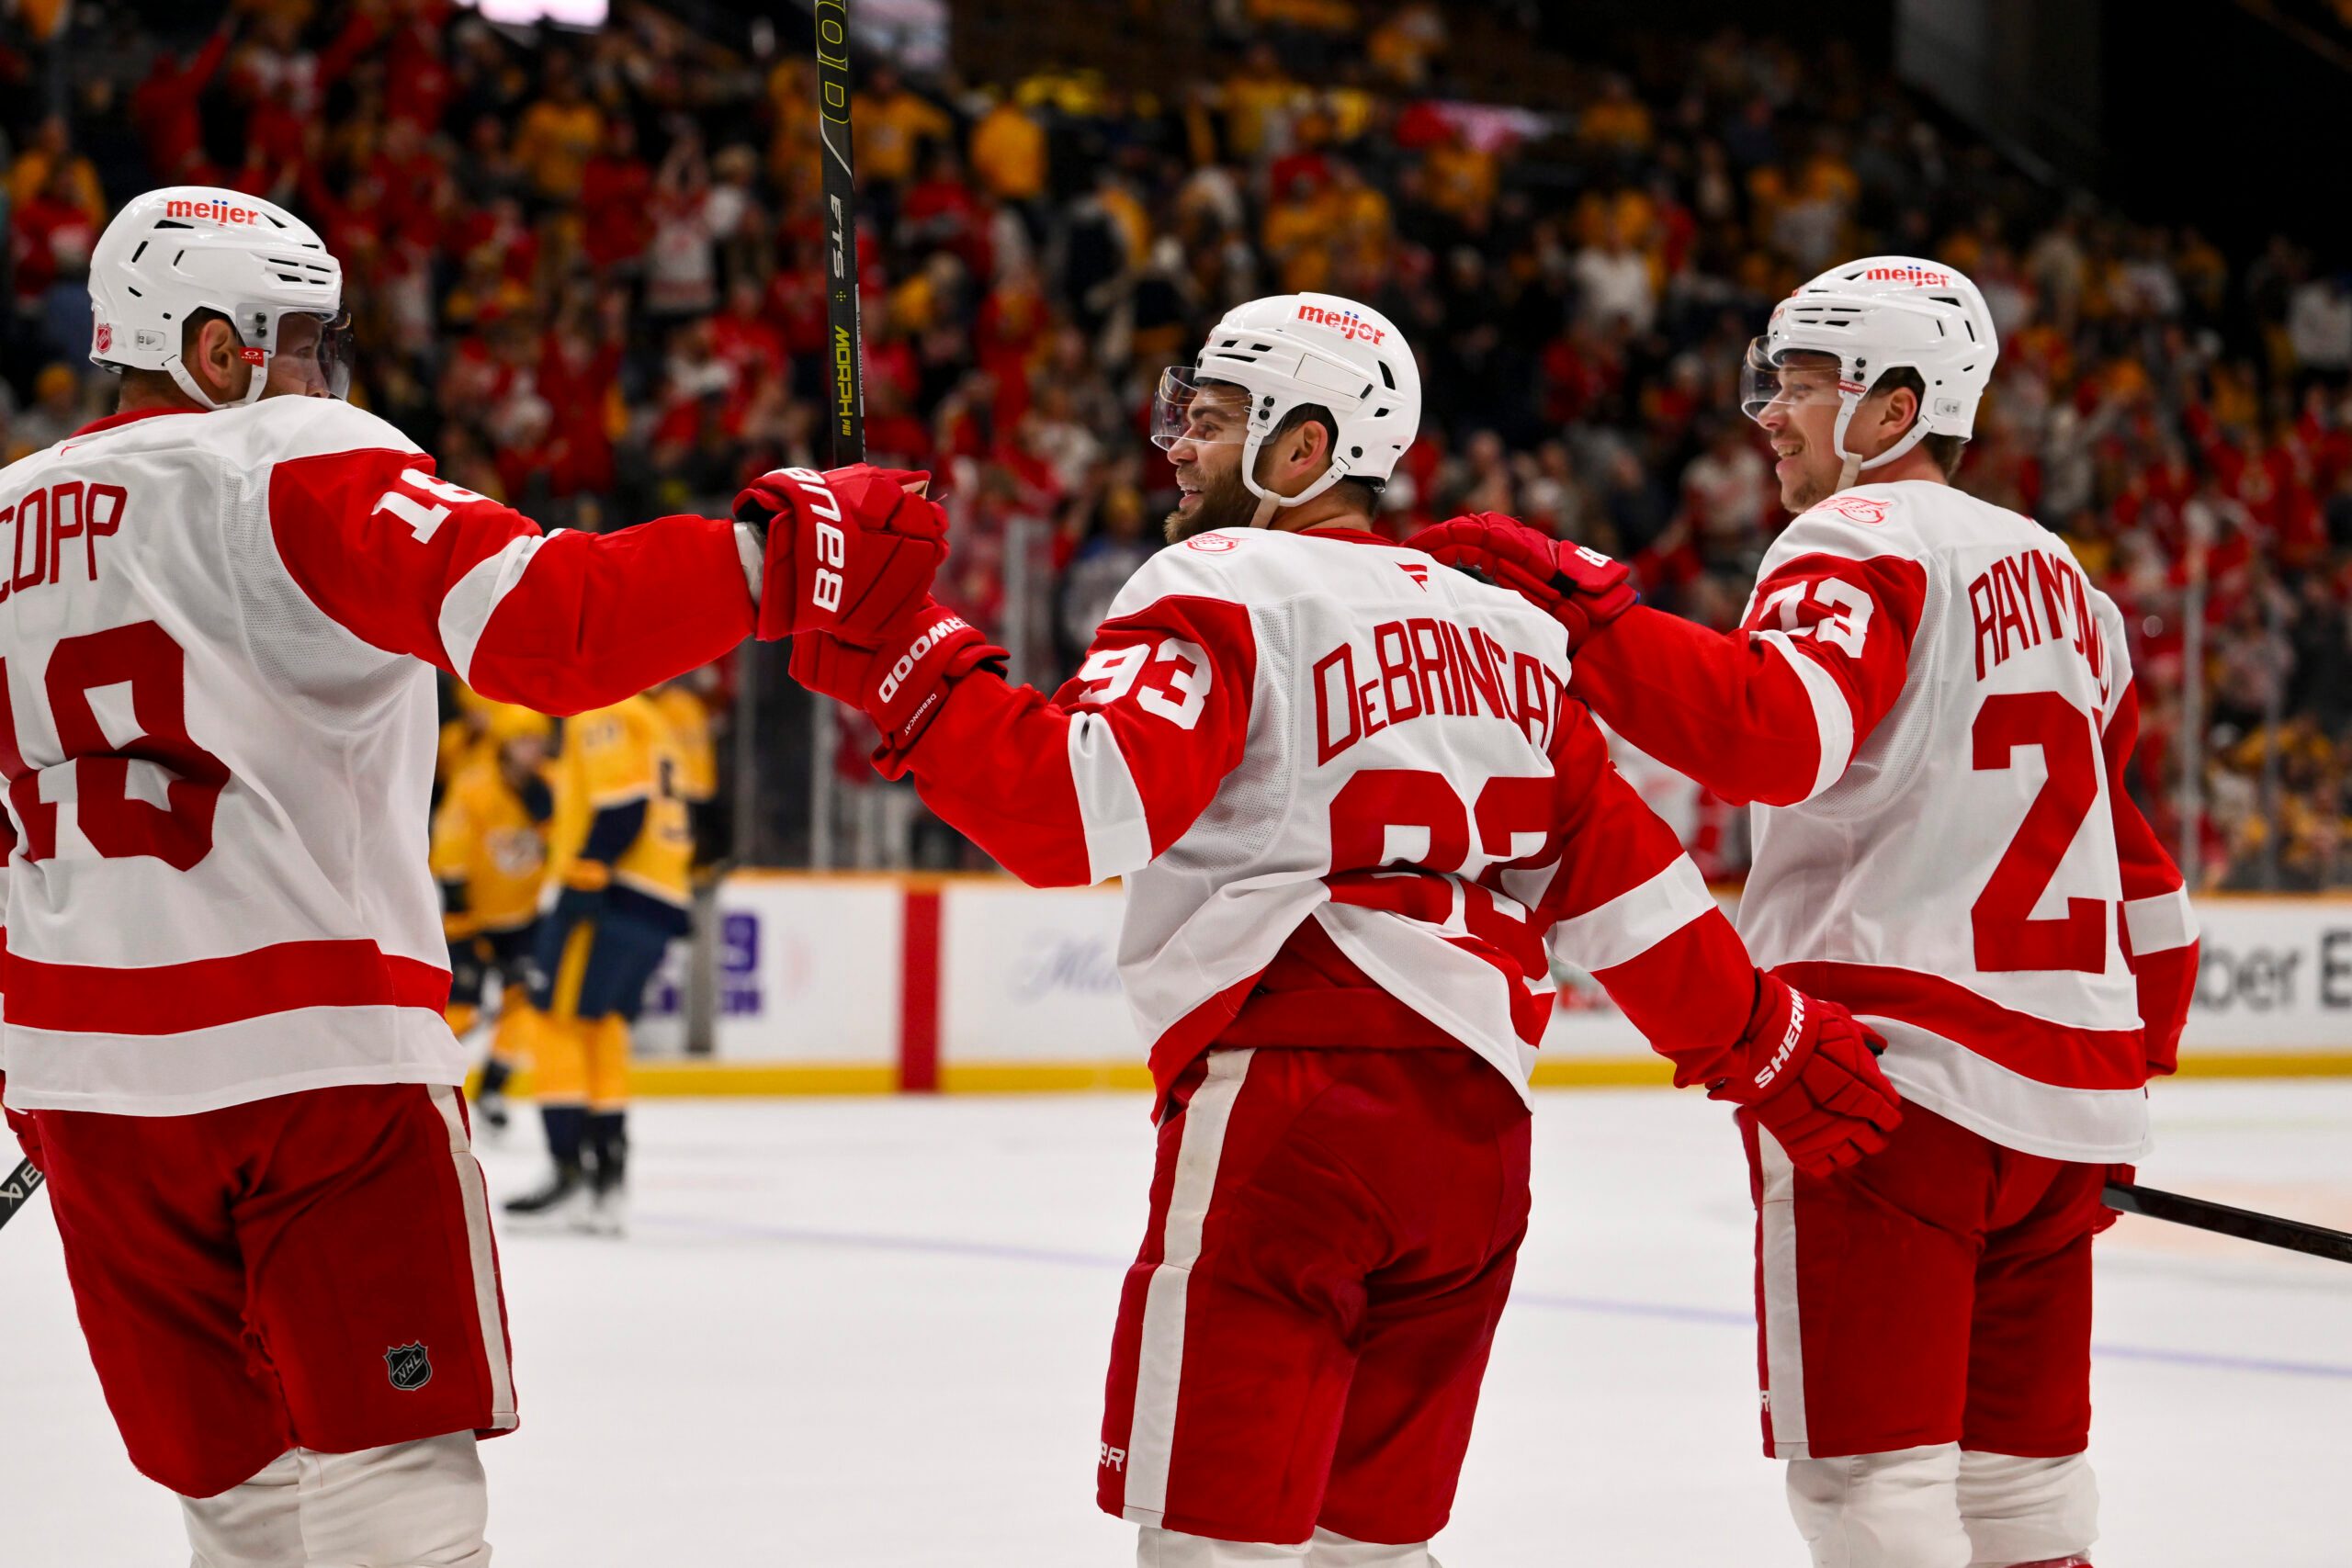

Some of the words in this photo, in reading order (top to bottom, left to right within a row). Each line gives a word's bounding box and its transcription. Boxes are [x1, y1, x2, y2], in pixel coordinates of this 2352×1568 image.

[815, 0, 850, 124] OD
[166, 199, 259, 226] meijer
[830, 193, 844, 279] ETS
[1866, 265, 1951, 288] meijer
[1297, 304, 1385, 345] meijer
[834, 324, 853, 416] MORPH
[370, 468, 503, 544] 18
[763, 467, 844, 613] BAUE
[904, 693, 937, 736] DEBRINCAT
[1078, 637, 1213, 730] 93
[1971, 691, 2136, 976] 2
[1754, 984, 1805, 1089] SHERW
[397, 1354, 422, 1382] NHL
